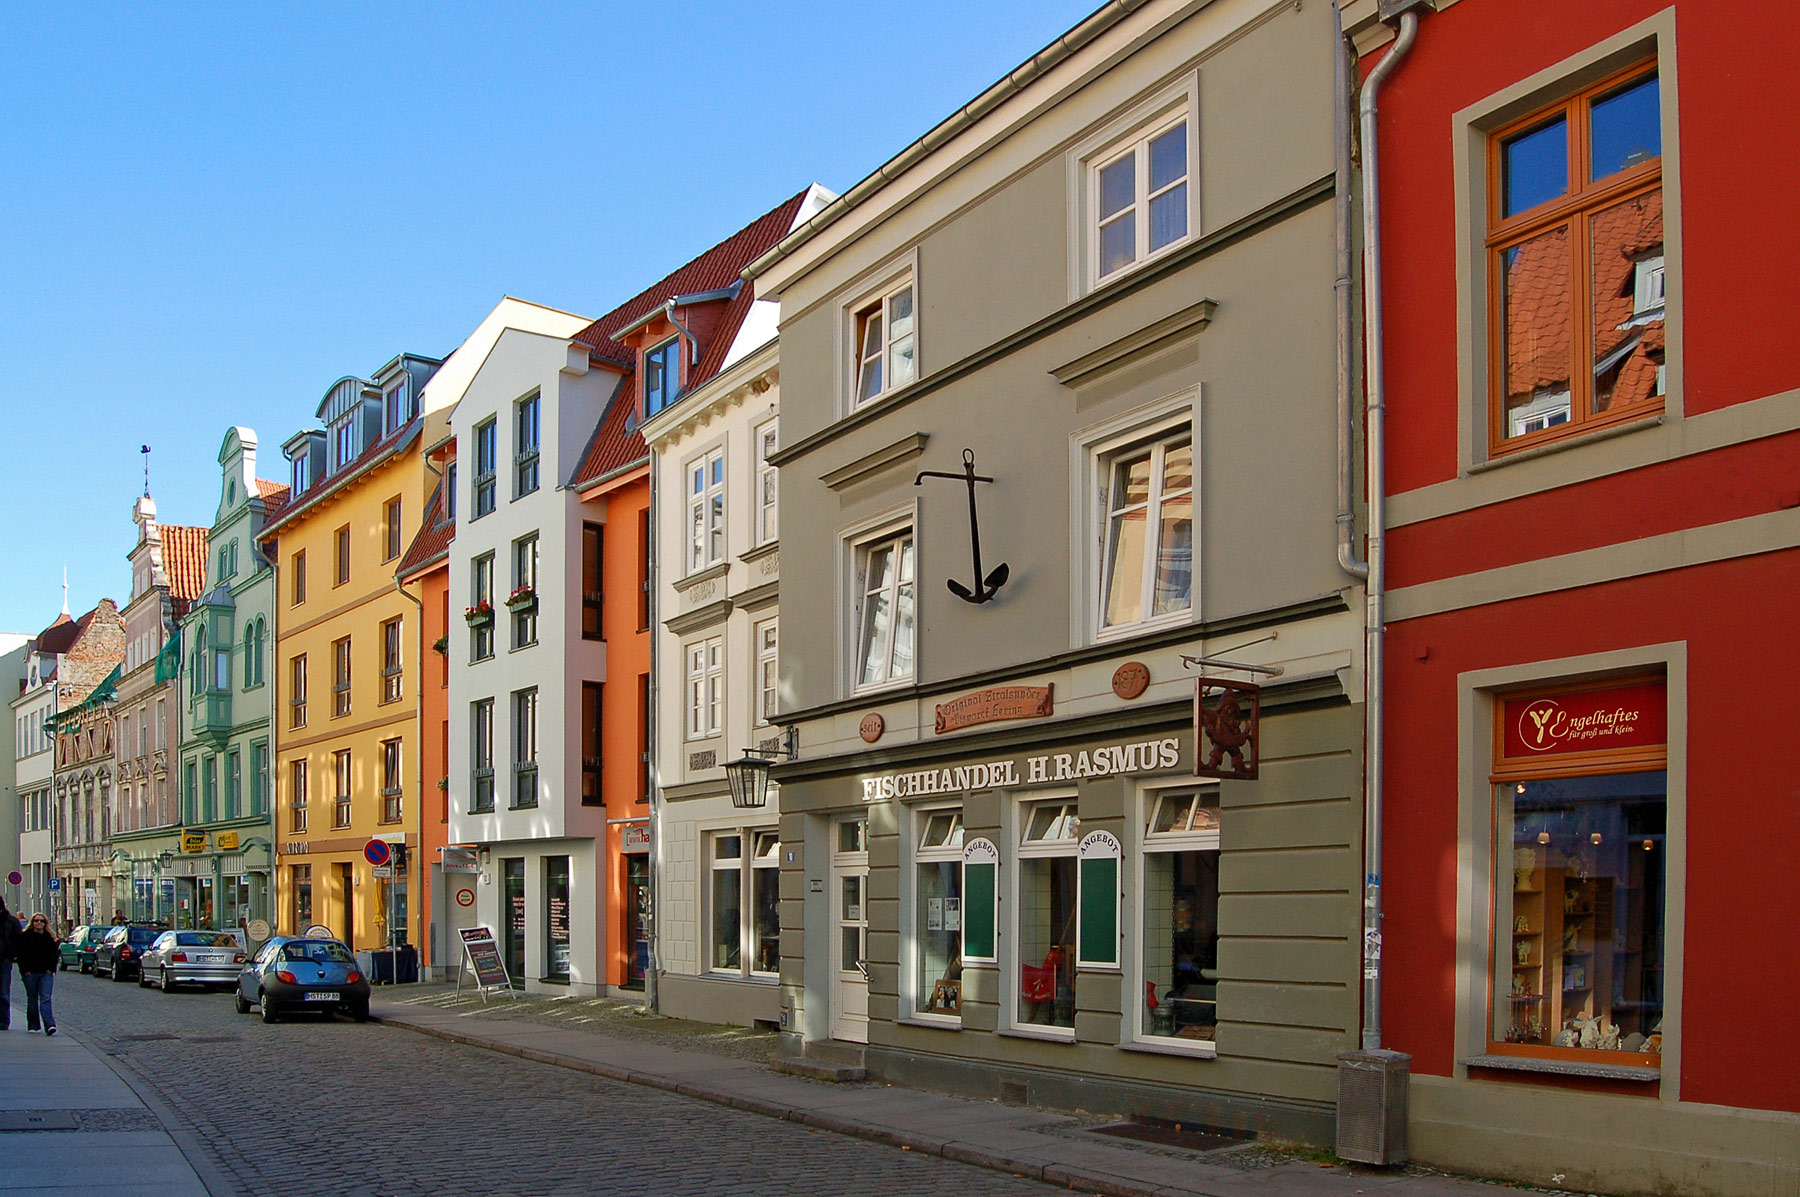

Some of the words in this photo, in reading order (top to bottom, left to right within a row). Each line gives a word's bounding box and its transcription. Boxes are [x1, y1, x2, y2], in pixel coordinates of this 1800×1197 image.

[1117, 669, 1142, 690] 1871
[943, 694, 982, 716] Original
[863, 720, 877, 733] seit
[1549, 708, 1639, 738] Engelhaftes
[1567, 729, 1580, 741] für
[1580, 728, 1598, 740] groß
[1599, 724, 1613, 736] und
[862, 760, 1020, 801] FISCHHANDEL
[1027, 738, 1180, 784] H.RASMUS
[964, 841, 997, 860] ANGEBOT
[1080, 833, 1119, 855] ANGEBOT
[51, 880, 58, 889] P
